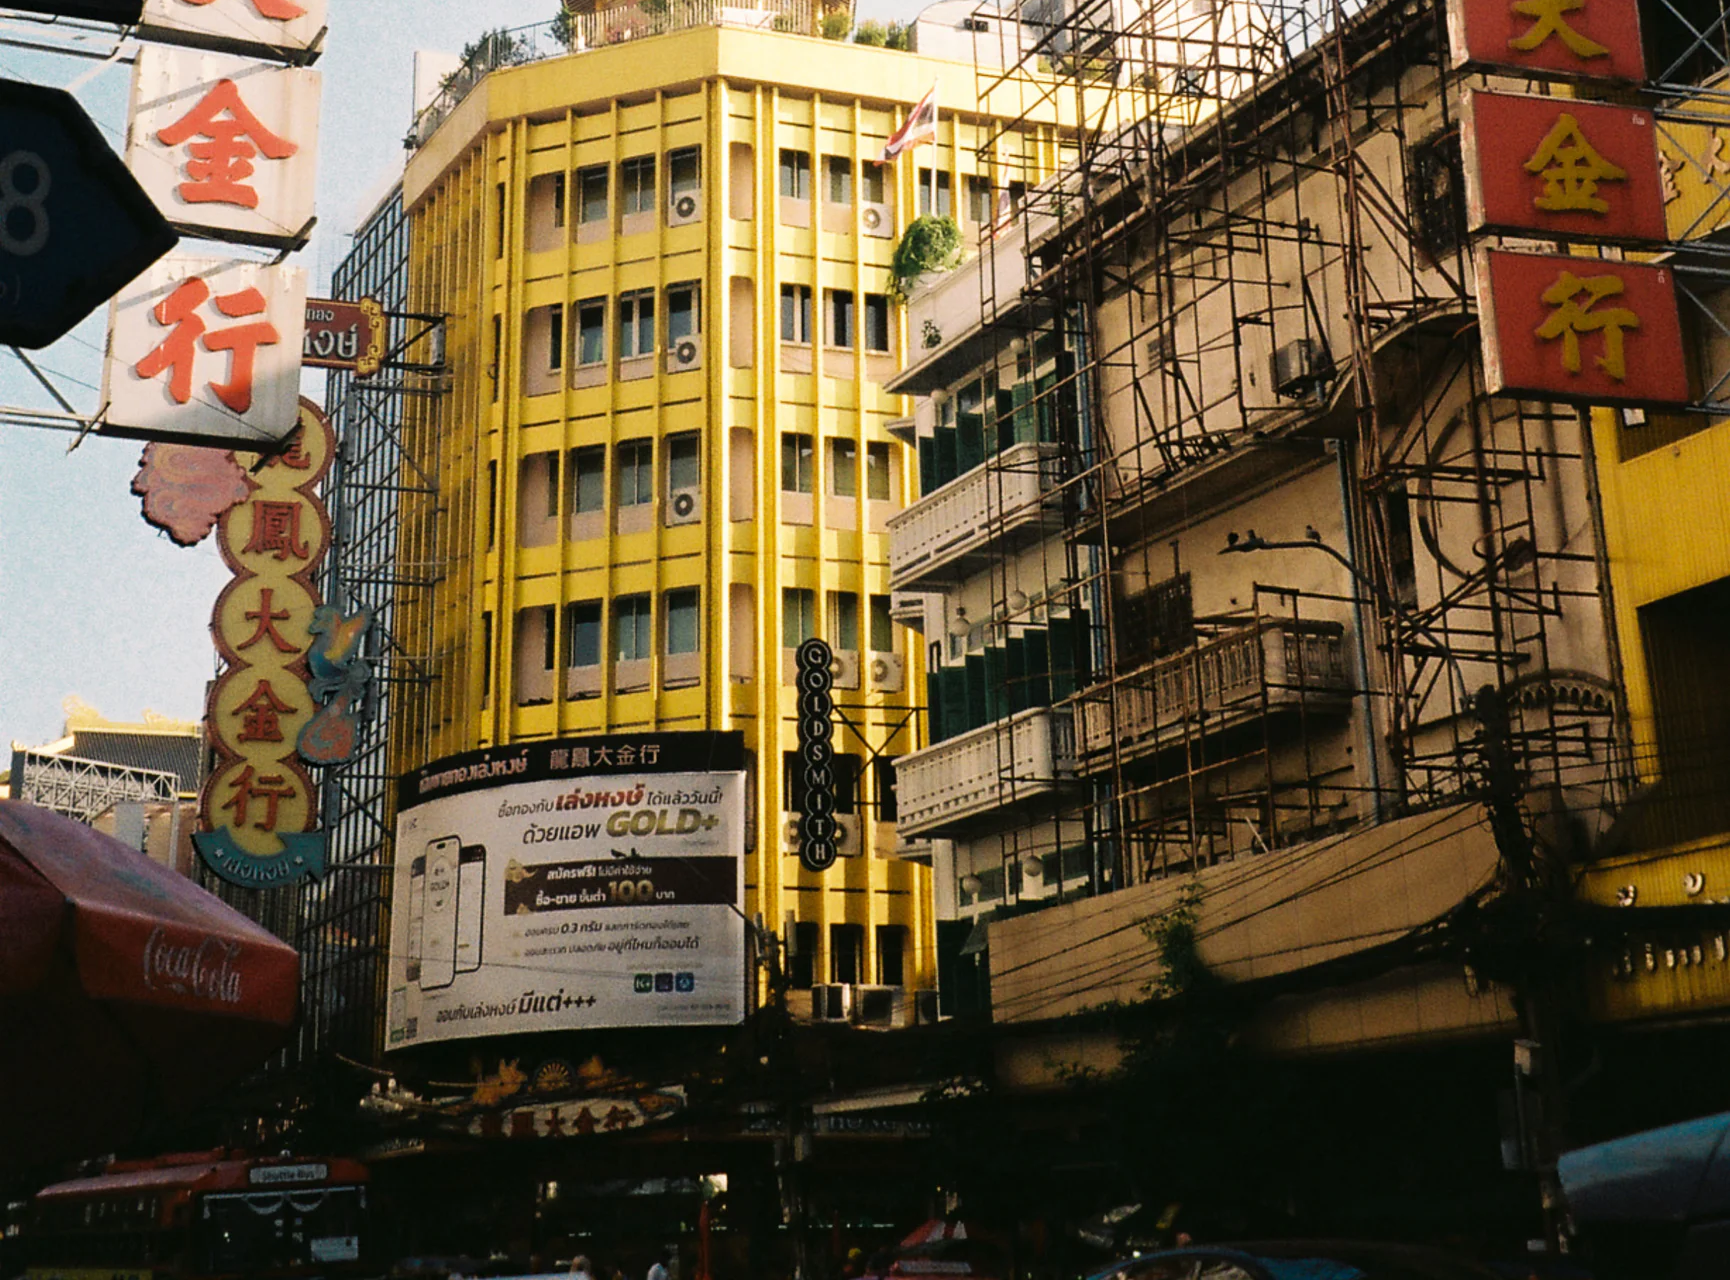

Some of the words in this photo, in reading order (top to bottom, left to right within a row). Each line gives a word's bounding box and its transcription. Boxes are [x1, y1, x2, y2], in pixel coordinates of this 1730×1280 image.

[549, 744, 661, 770] 龍鳳大金行
[808, 648, 827, 860] GOLDSMITH
[522, 822, 601, 845] ด้วยแอพ
[605, 808, 720, 838] GOLD+
[608, 879, 654, 904] 100
[656, 890, 676, 900] บาท
